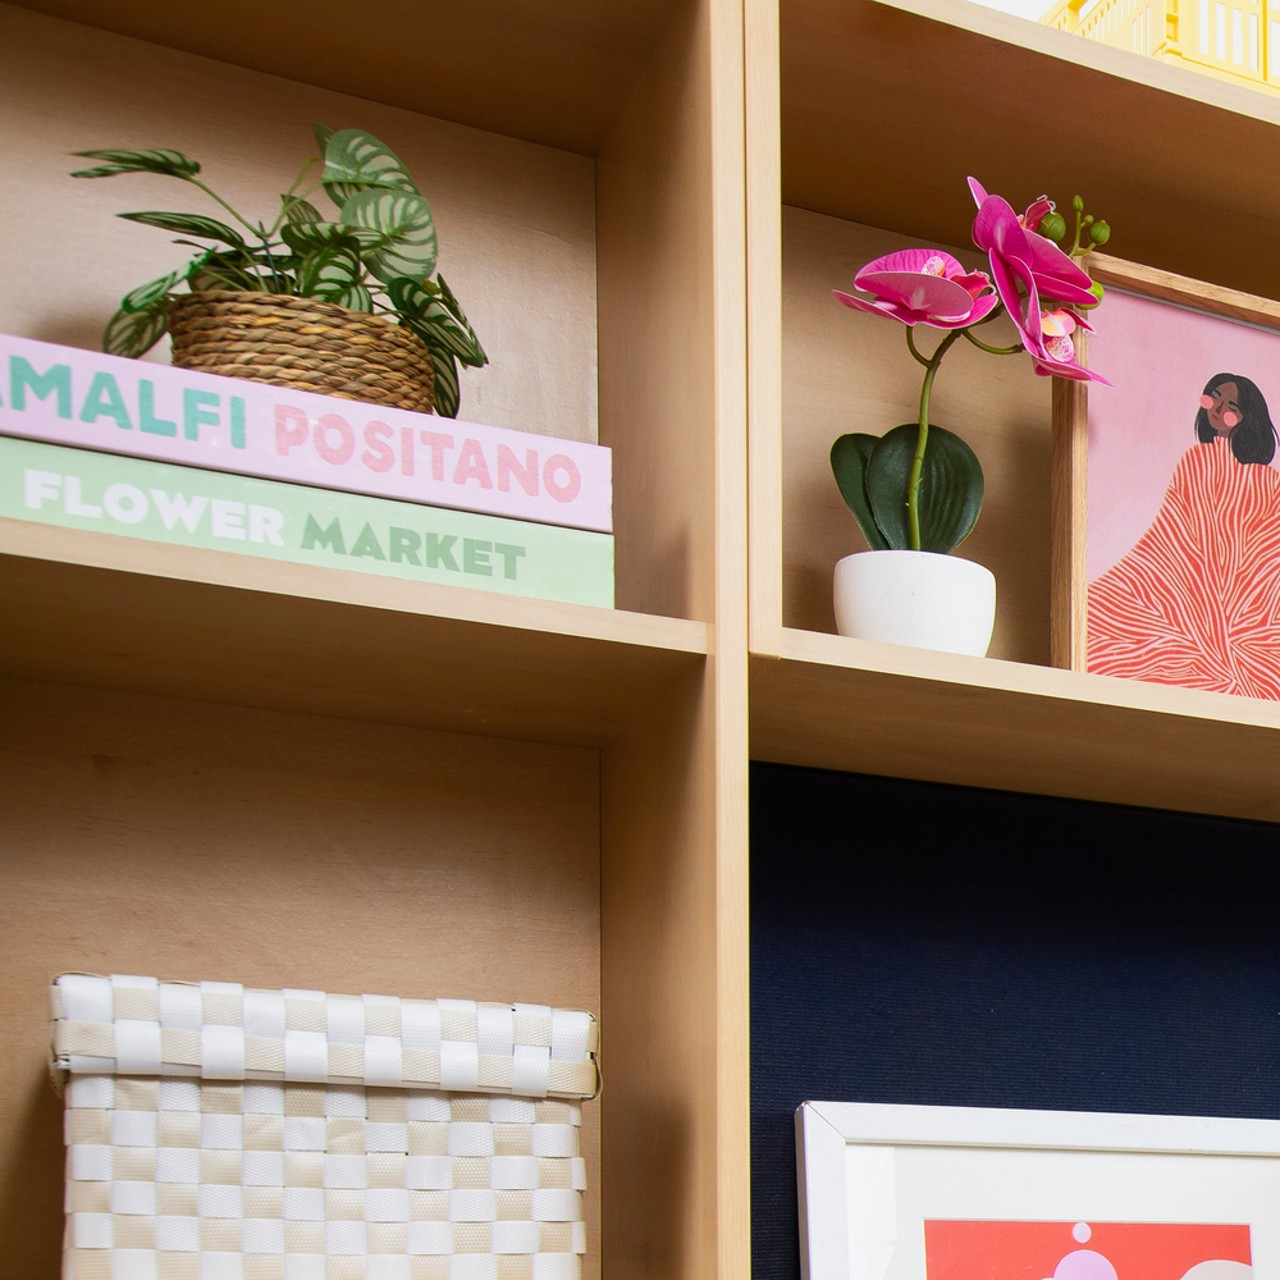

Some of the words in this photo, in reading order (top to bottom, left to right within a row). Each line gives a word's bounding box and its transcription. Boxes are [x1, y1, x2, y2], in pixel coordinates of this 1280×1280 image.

[0, 355, 247, 450] MALFI
[274, 402, 582, 504] POSITANO
[23, 468, 286, 547] FLOWER
[301, 512, 527, 580] MARKET
